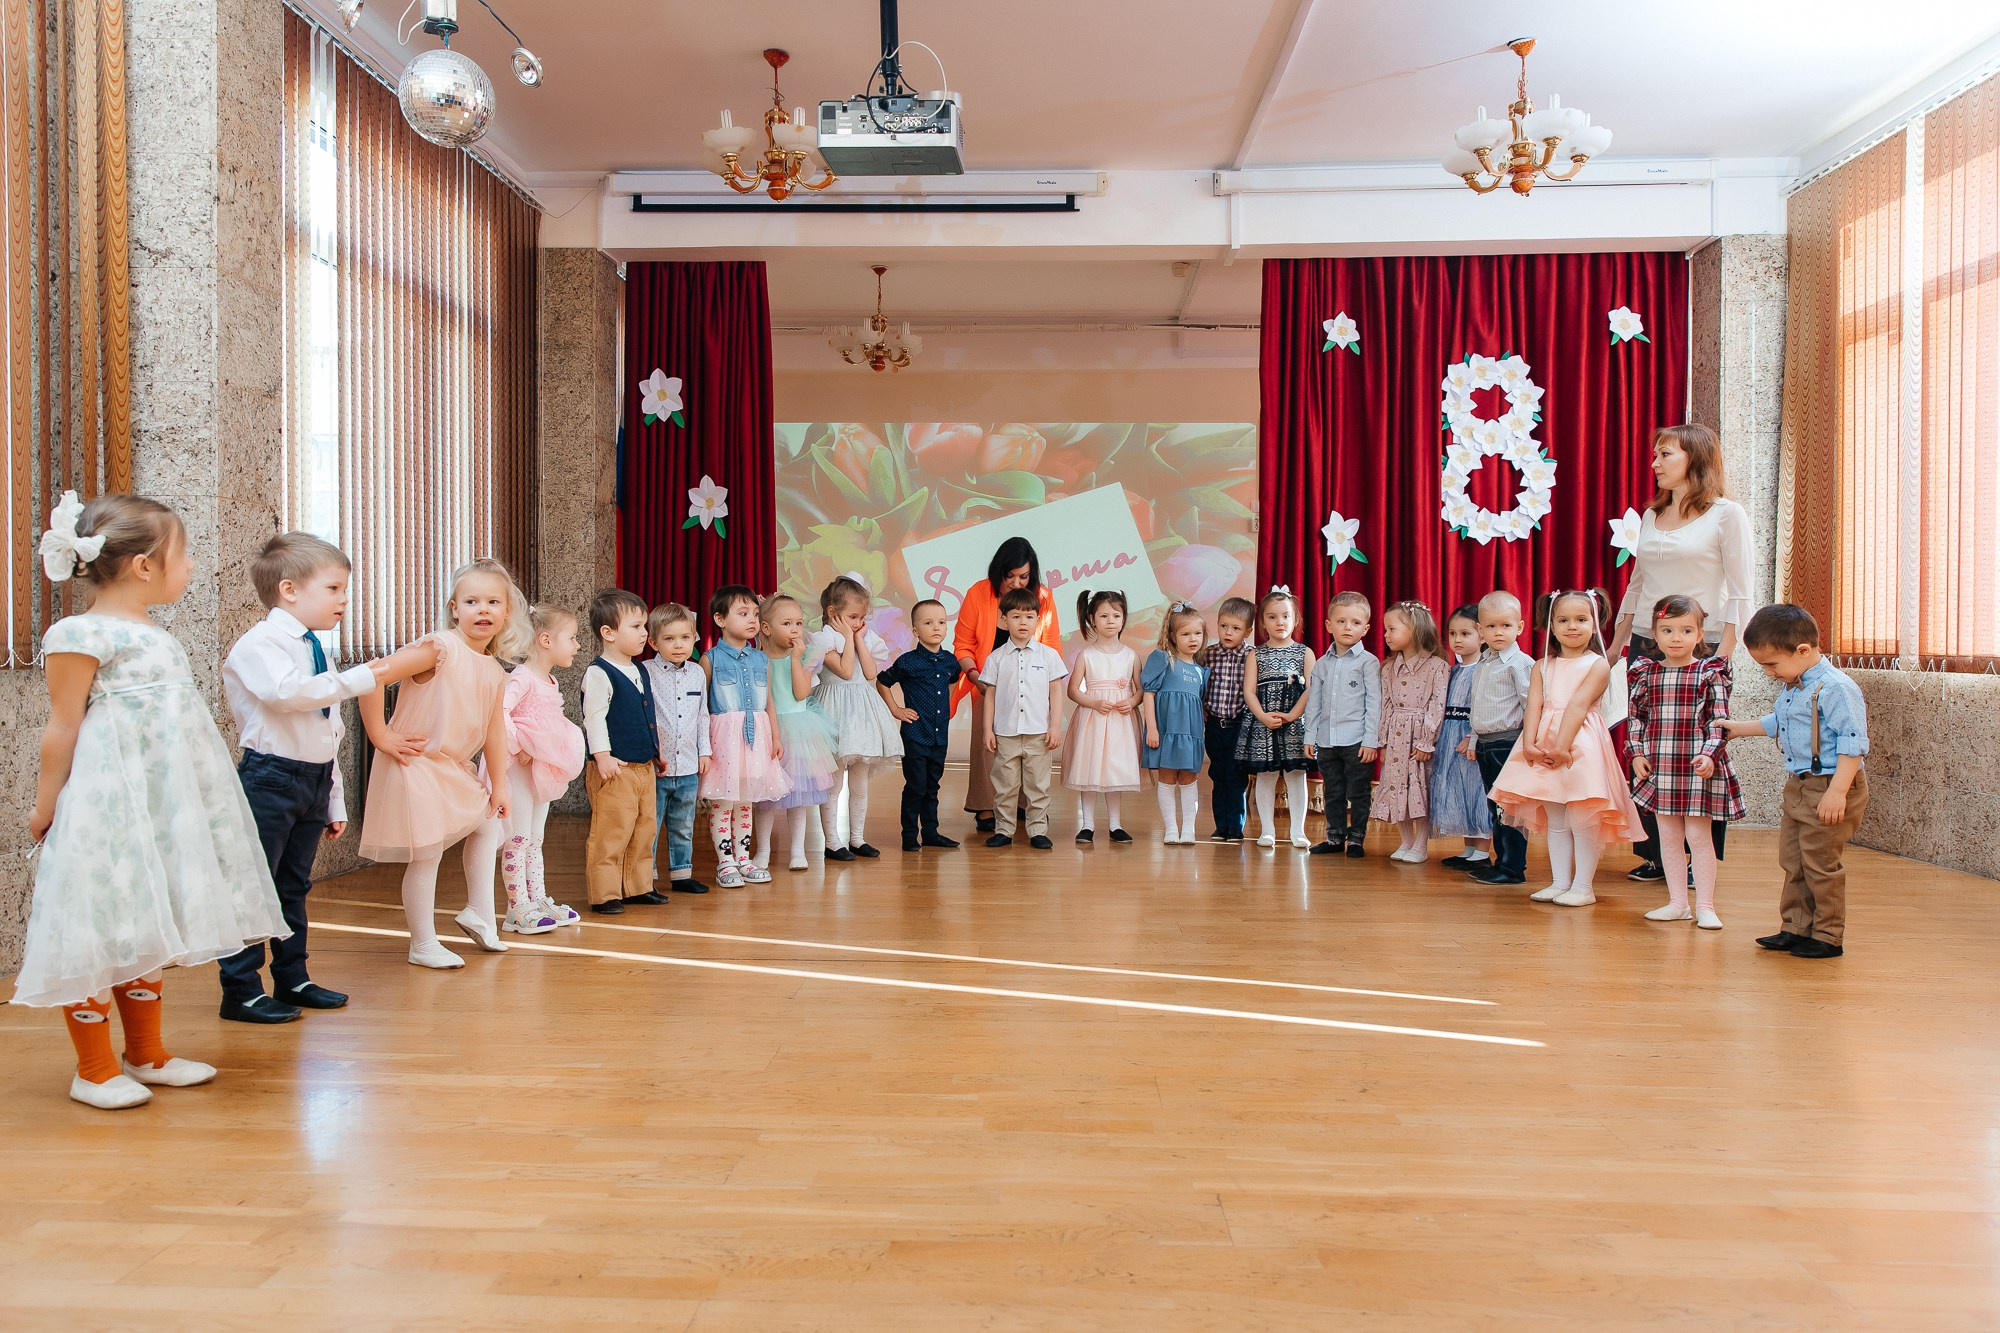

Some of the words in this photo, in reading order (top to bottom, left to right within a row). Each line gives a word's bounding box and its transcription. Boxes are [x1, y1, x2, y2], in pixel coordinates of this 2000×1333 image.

[1441, 352, 1557, 546] 8
[924, 565, 964, 621] 8
[1045, 552, 1138, 589] рта
